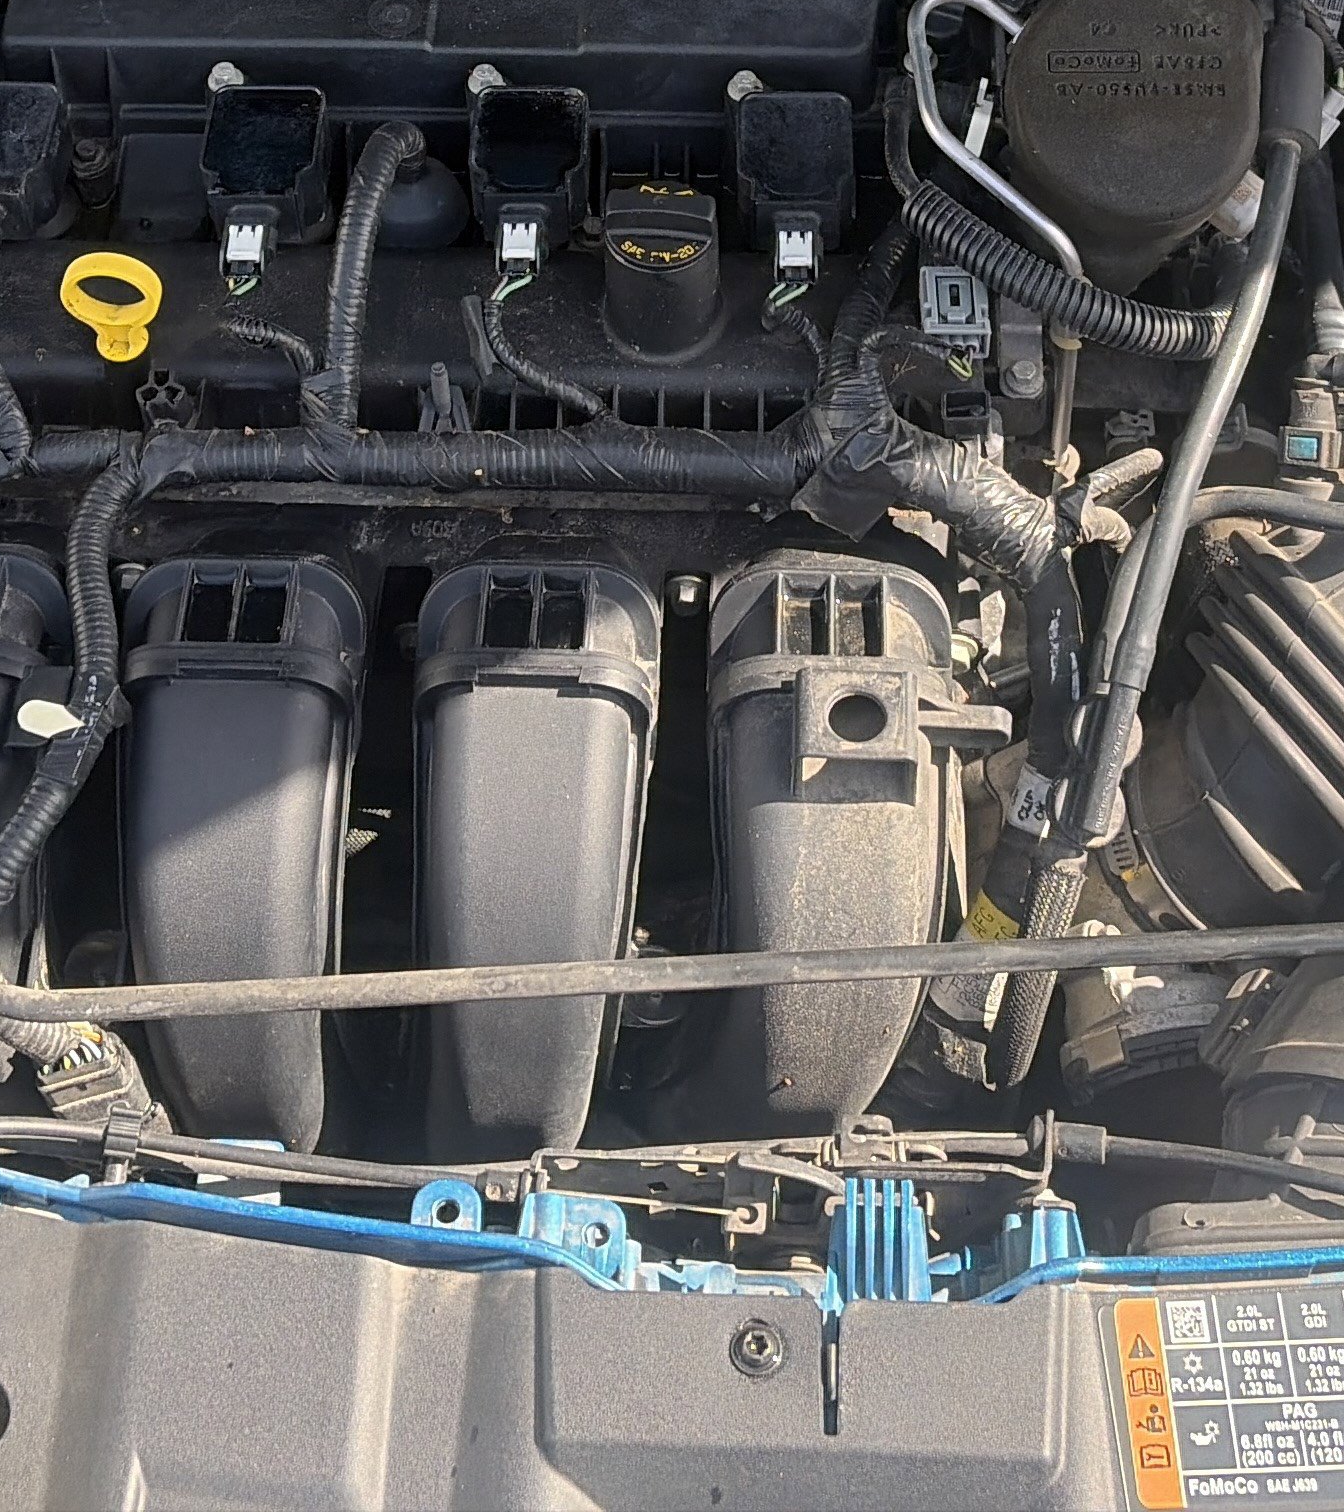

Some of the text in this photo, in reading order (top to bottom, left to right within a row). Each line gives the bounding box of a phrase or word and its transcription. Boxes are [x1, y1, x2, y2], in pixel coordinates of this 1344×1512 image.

[1053, 54, 1138, 69] FoMoCo
[621, 240, 645, 259] SAE
[972, 907, 994, 938] AFG
[1236, 1305, 1262, 1318] 2.0L
[1300, 1303, 1326, 1316] 2.0L
[1259, 1318, 1275, 1331] ST
[1304, 1316, 1327, 1329] GDI
[1232, 1348, 1281, 1367] 0.60 kg
[1297, 1347, 1326, 1364] 0.60
[1244, 1368, 1275, 1380] 21 oz
[1309, 1364, 1341, 1377] 21 oz
[1171, 1377, 1223, 1393] R-134a
[1240, 1382, 1284, 1396] 1.32 lbs
[1305, 1380, 1329, 1393] 1.32
[1282, 1403, 1318, 1419] PAG
[1277, 1436, 1295, 1448] oz
[1307, 1432, 1330, 1447] 4.0
[1333, 1431, 1344, 1446] fl
[1242, 1449, 1301, 1468] (200 cc)
[1311, 1448, 1343, 1465] (120
[1188, 1477, 1318, 1496] FoMoCo SAE J639
